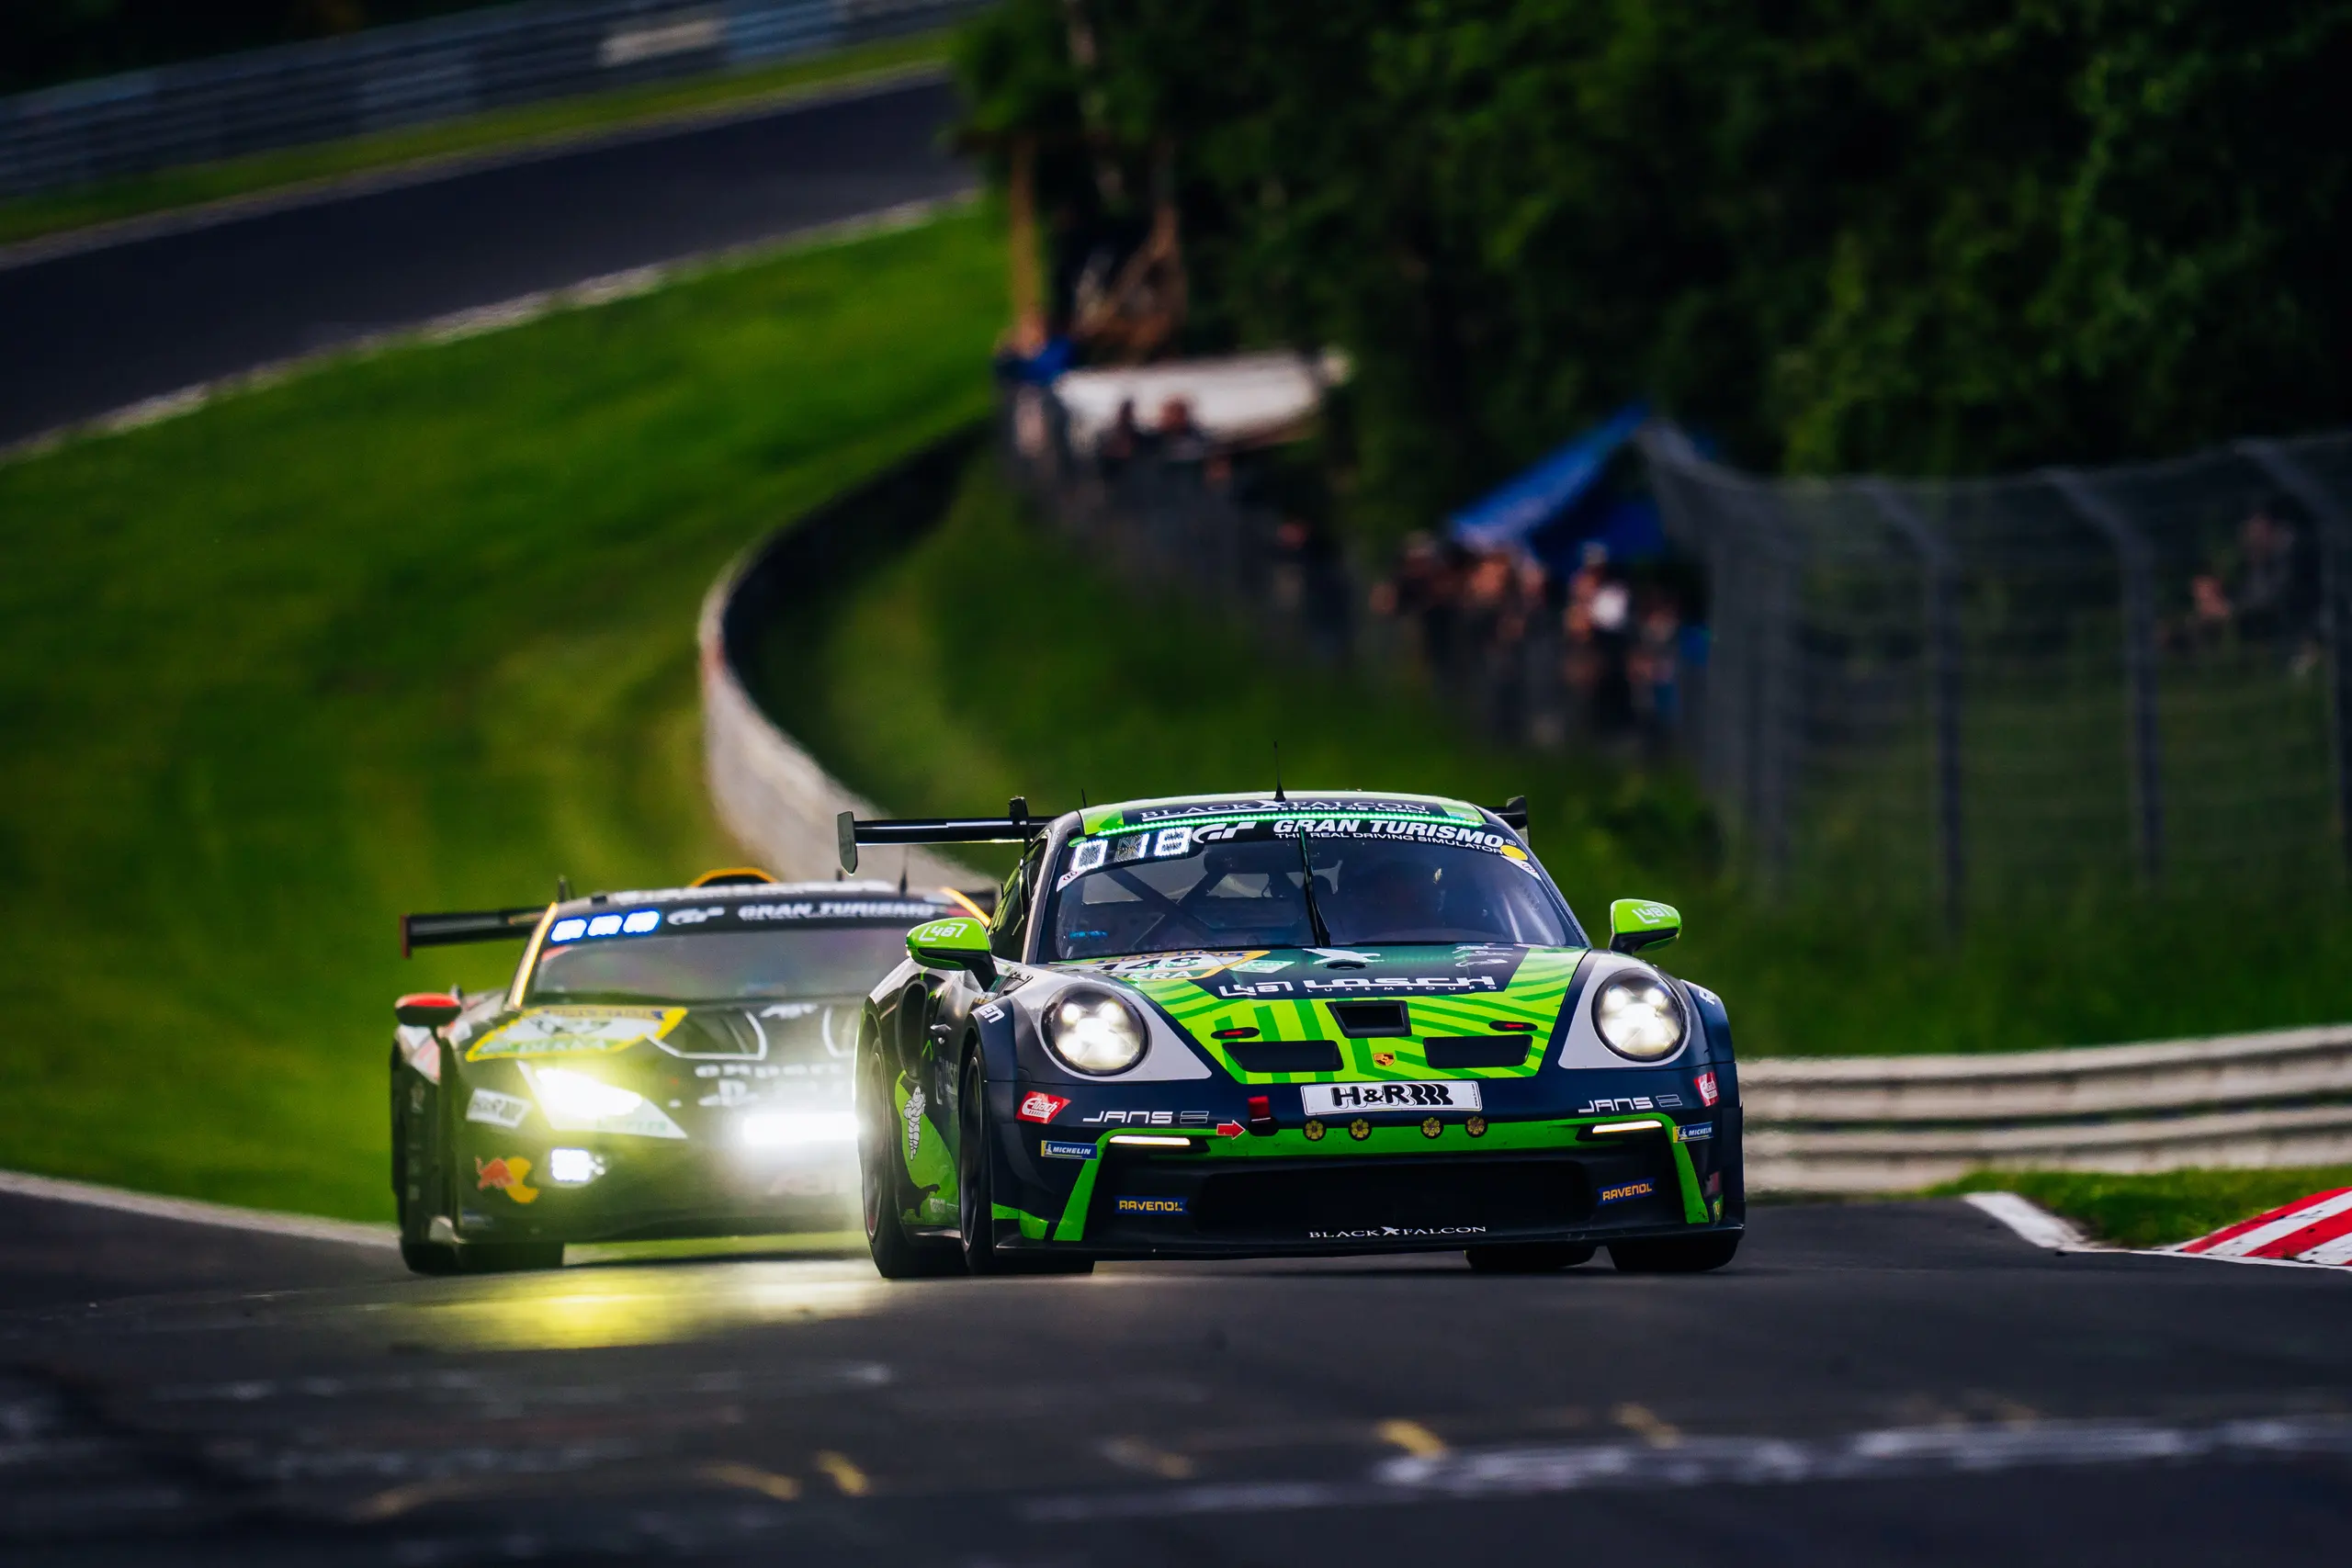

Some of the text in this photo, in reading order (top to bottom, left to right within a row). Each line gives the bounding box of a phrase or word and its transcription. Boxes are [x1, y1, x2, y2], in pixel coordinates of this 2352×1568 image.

[1139, 801, 1426, 818] BLACK FALCON
[1273, 819, 1504, 848] GRAN TURISMO
[1352, 833, 1418, 842] DRIVING
[1418, 836, 1503, 855] SIMULATOR
[738, 904, 813, 919] GRAN
[1303, 976, 1496, 987] LOSCH
[1307, 985, 1498, 993] LUXEMBOURG
[1022, 1097, 1058, 1119] Eibach
[1052, 1146, 1091, 1155] MICHELIN
[1602, 1182, 1653, 1201] RAVENOL
[1118, 1200, 1183, 1212] RAVENOL
[1309, 1226, 1487, 1238] BLACK FALCON
